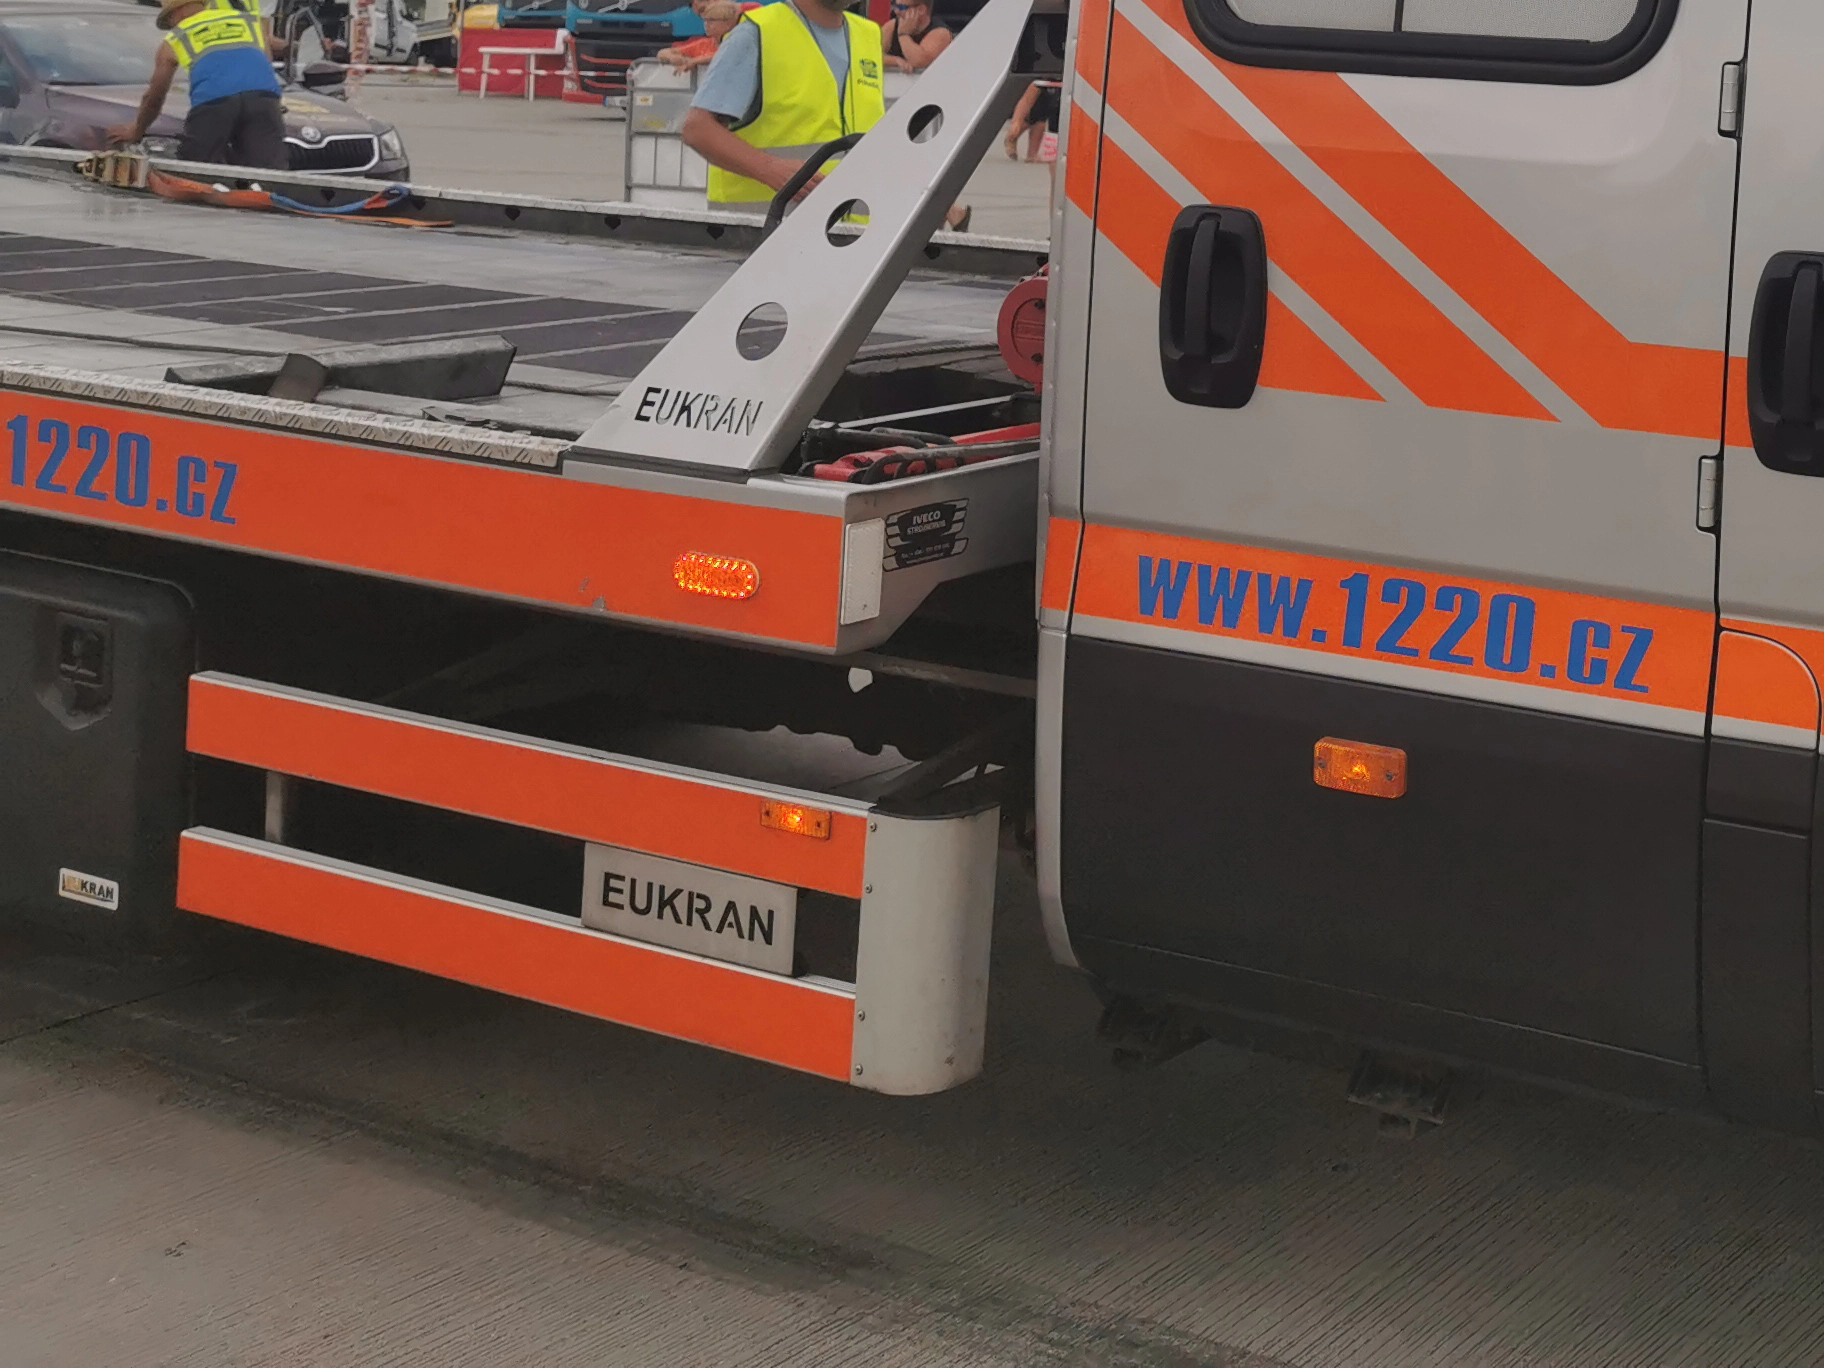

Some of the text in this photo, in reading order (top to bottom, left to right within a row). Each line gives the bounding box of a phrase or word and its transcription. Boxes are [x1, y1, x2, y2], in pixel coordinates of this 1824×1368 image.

[634, 386, 763, 437] EUKRAN
[912, 510, 941, 525] IVECO
[602, 871, 774, 946] EUKRAN
